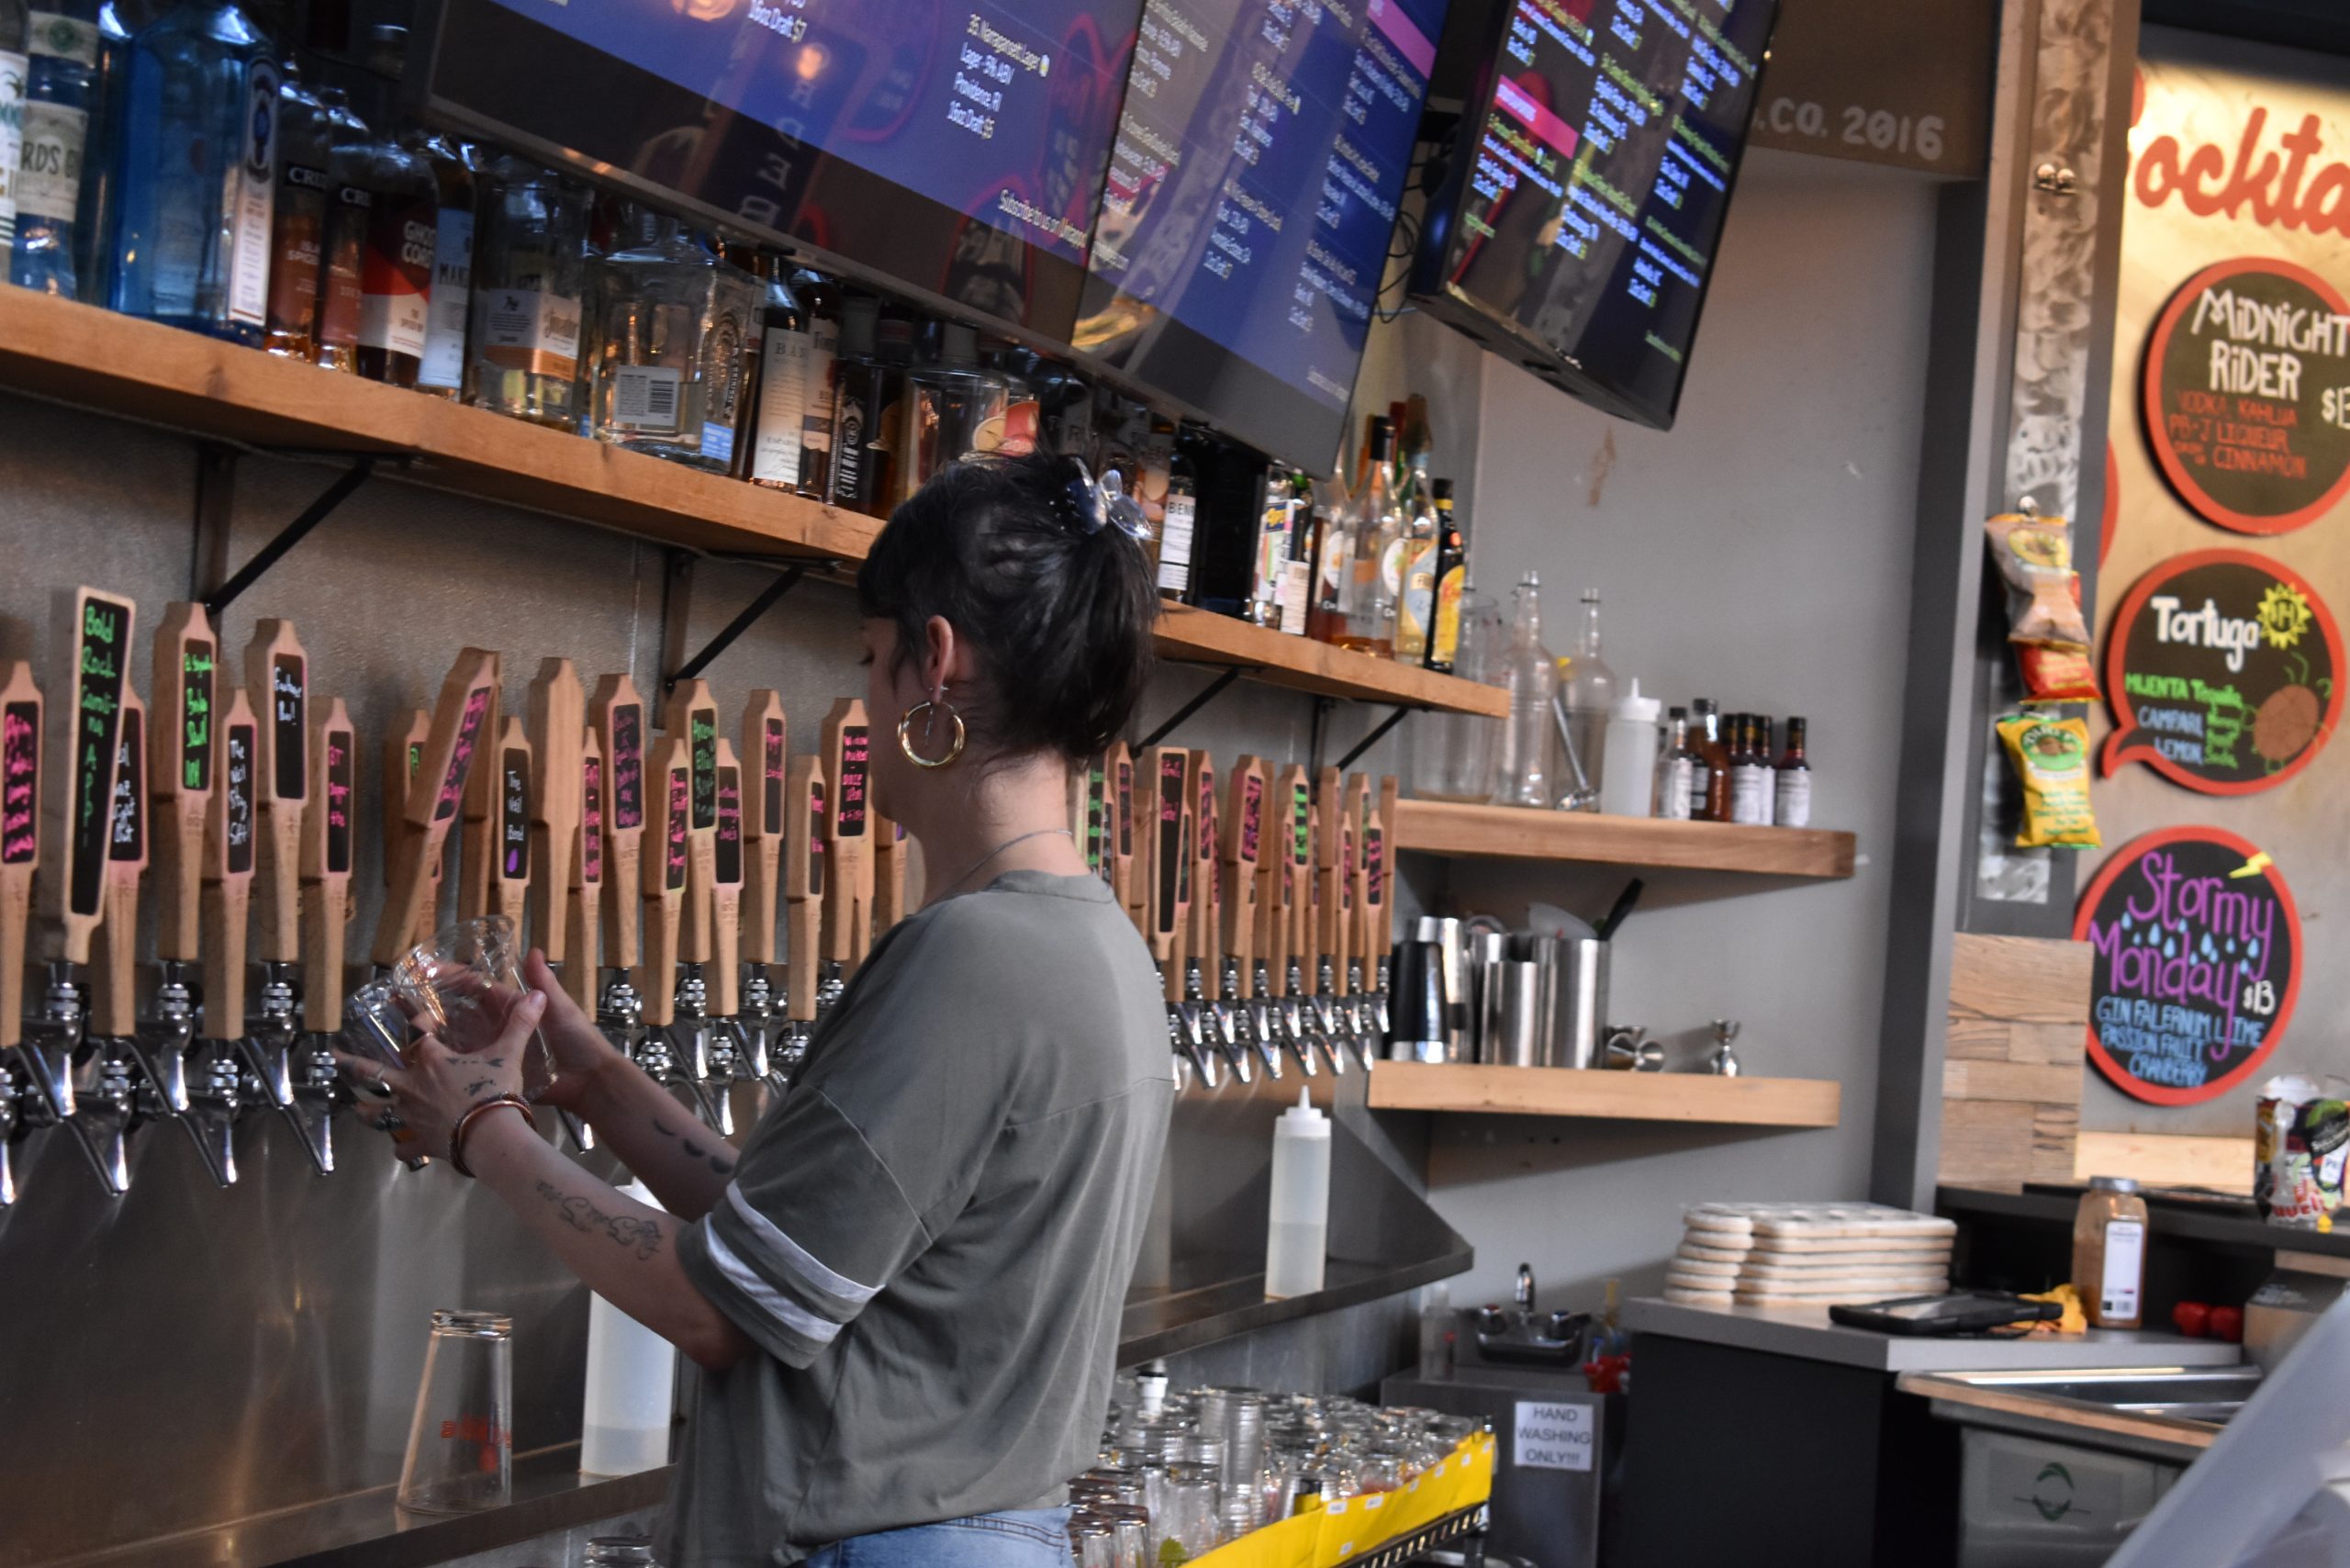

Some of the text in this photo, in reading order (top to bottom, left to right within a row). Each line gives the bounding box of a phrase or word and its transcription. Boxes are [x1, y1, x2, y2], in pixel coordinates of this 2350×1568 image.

[20, 141, 61, 175] RDS
[1841, 106, 1944, 161] 2016
[2134, 107, 2350, 239] ockta
[2151, 596, 2260, 673] Tortuga
[2127, 851, 2274, 981] Stormy
[2088, 920, 2241, 1061] Monday
[1518, 1427, 1592, 1444] WASHING
[1534, 1406, 1578, 1422] HAND
